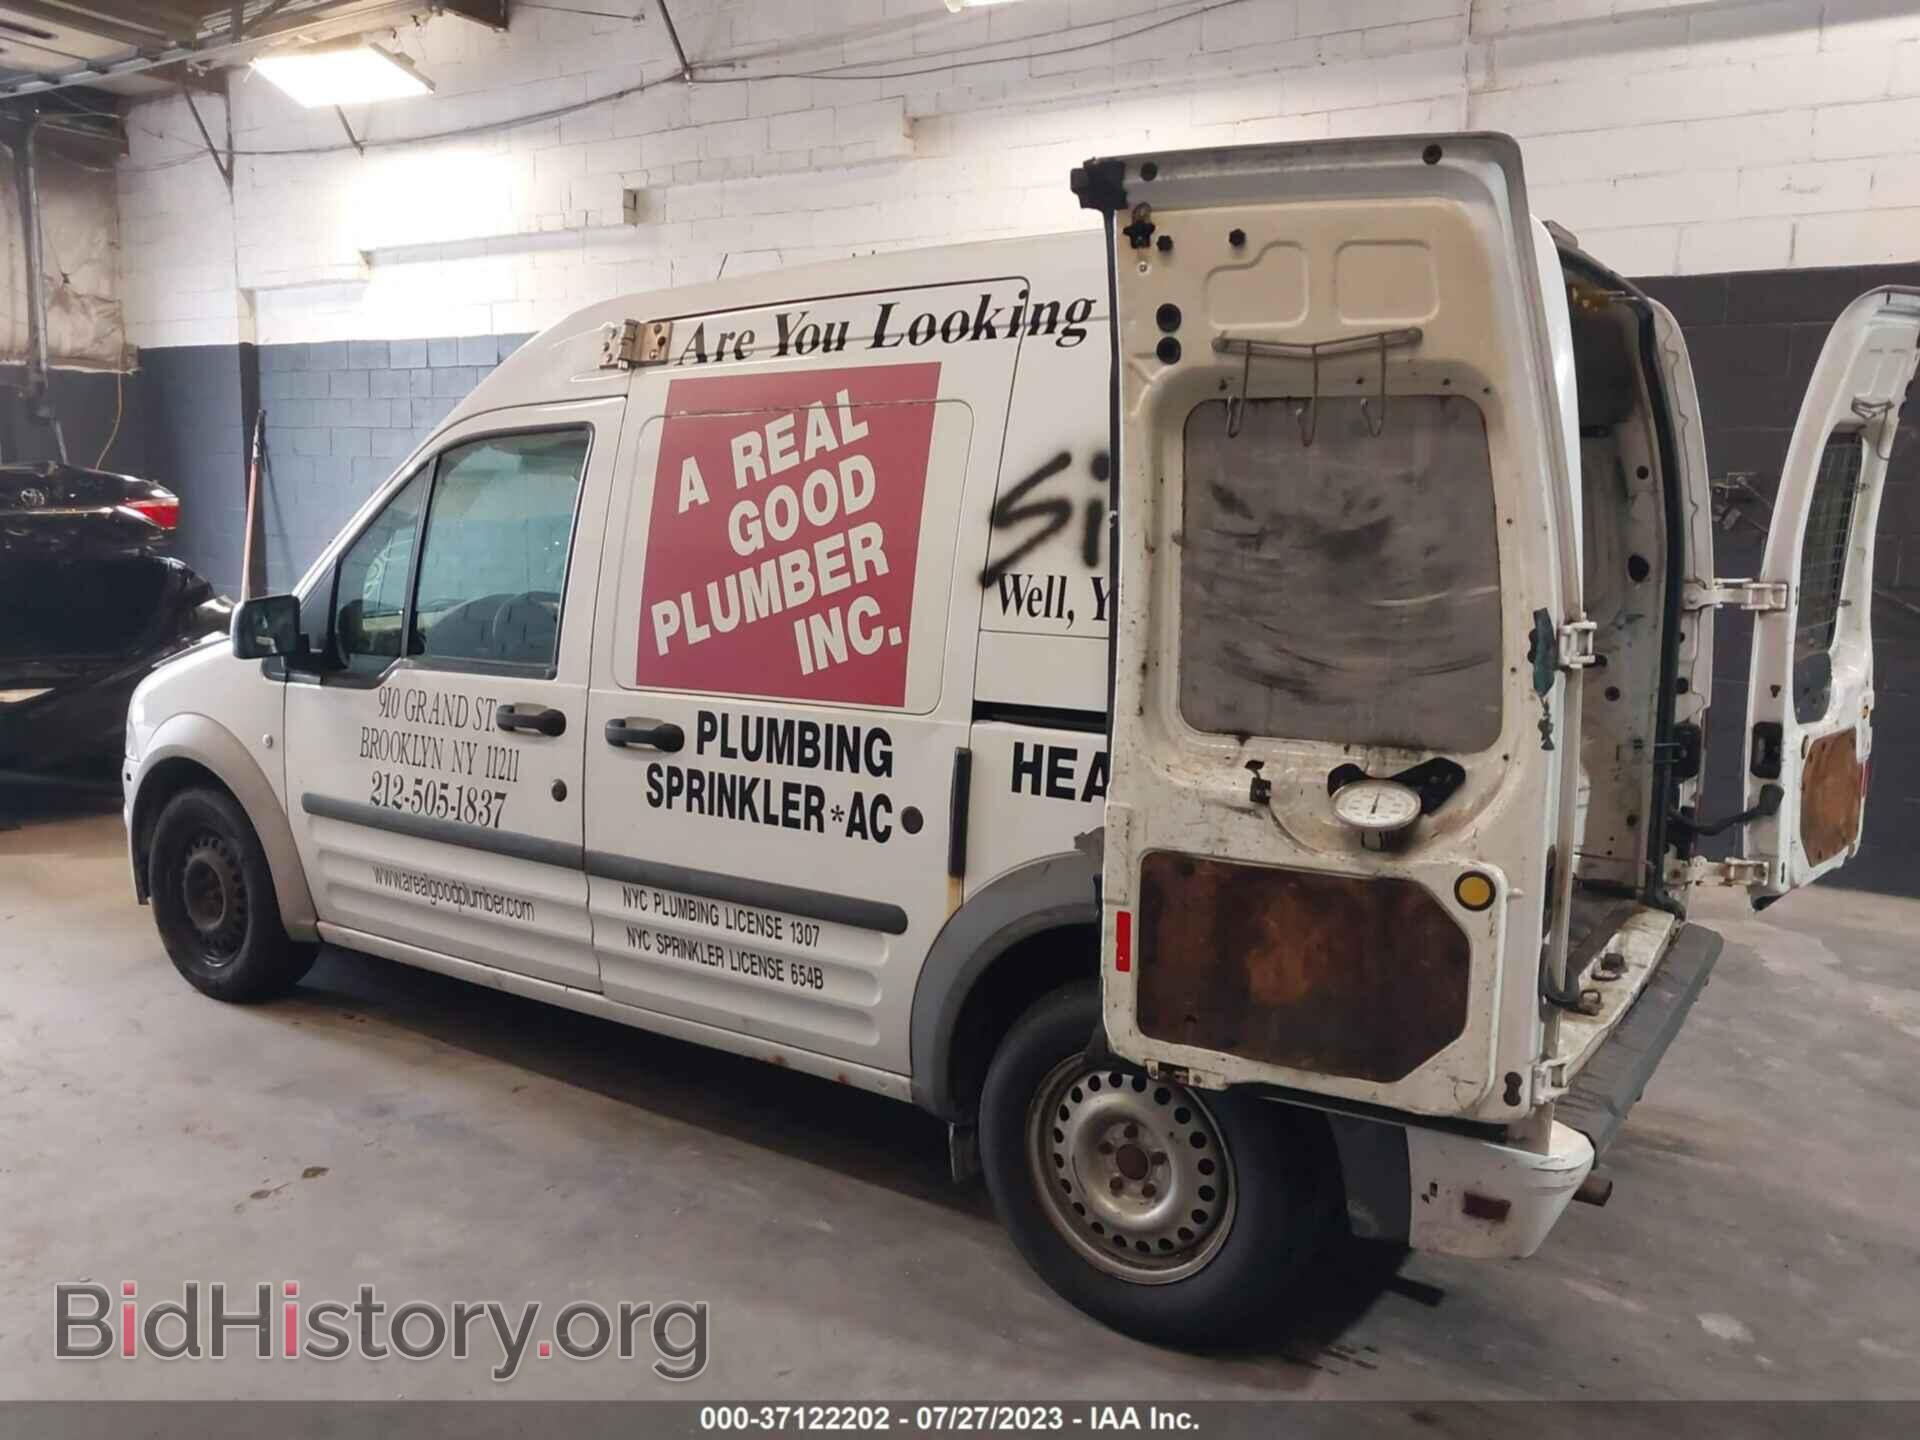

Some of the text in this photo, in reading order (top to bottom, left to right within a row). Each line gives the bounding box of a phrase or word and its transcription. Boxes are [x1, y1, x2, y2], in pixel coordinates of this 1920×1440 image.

[677, 290, 1096, 365] Are You Looking
[678, 388, 868, 513] A REAL
[728, 454, 877, 557] GOOD
[651, 521, 890, 657] PLUMBER
[998, 572, 1075, 630] Well,
[793, 595, 903, 676] INC.
[379, 686, 400, 719] 910
[404, 688, 469, 729] GRAND
[359, 726, 520, 783] BROOKLYN NY 11211
[696, 710, 893, 778] PLUMBING
[370, 770, 508, 829] 212-505-1837
[372, 863, 535, 921] www.arealgoodplumber.com
[622, 886, 820, 947] NYC PLUMBING LICENSE 1307
[626, 926, 824, 990] NYC SPRINKLER LICENSE 654B
